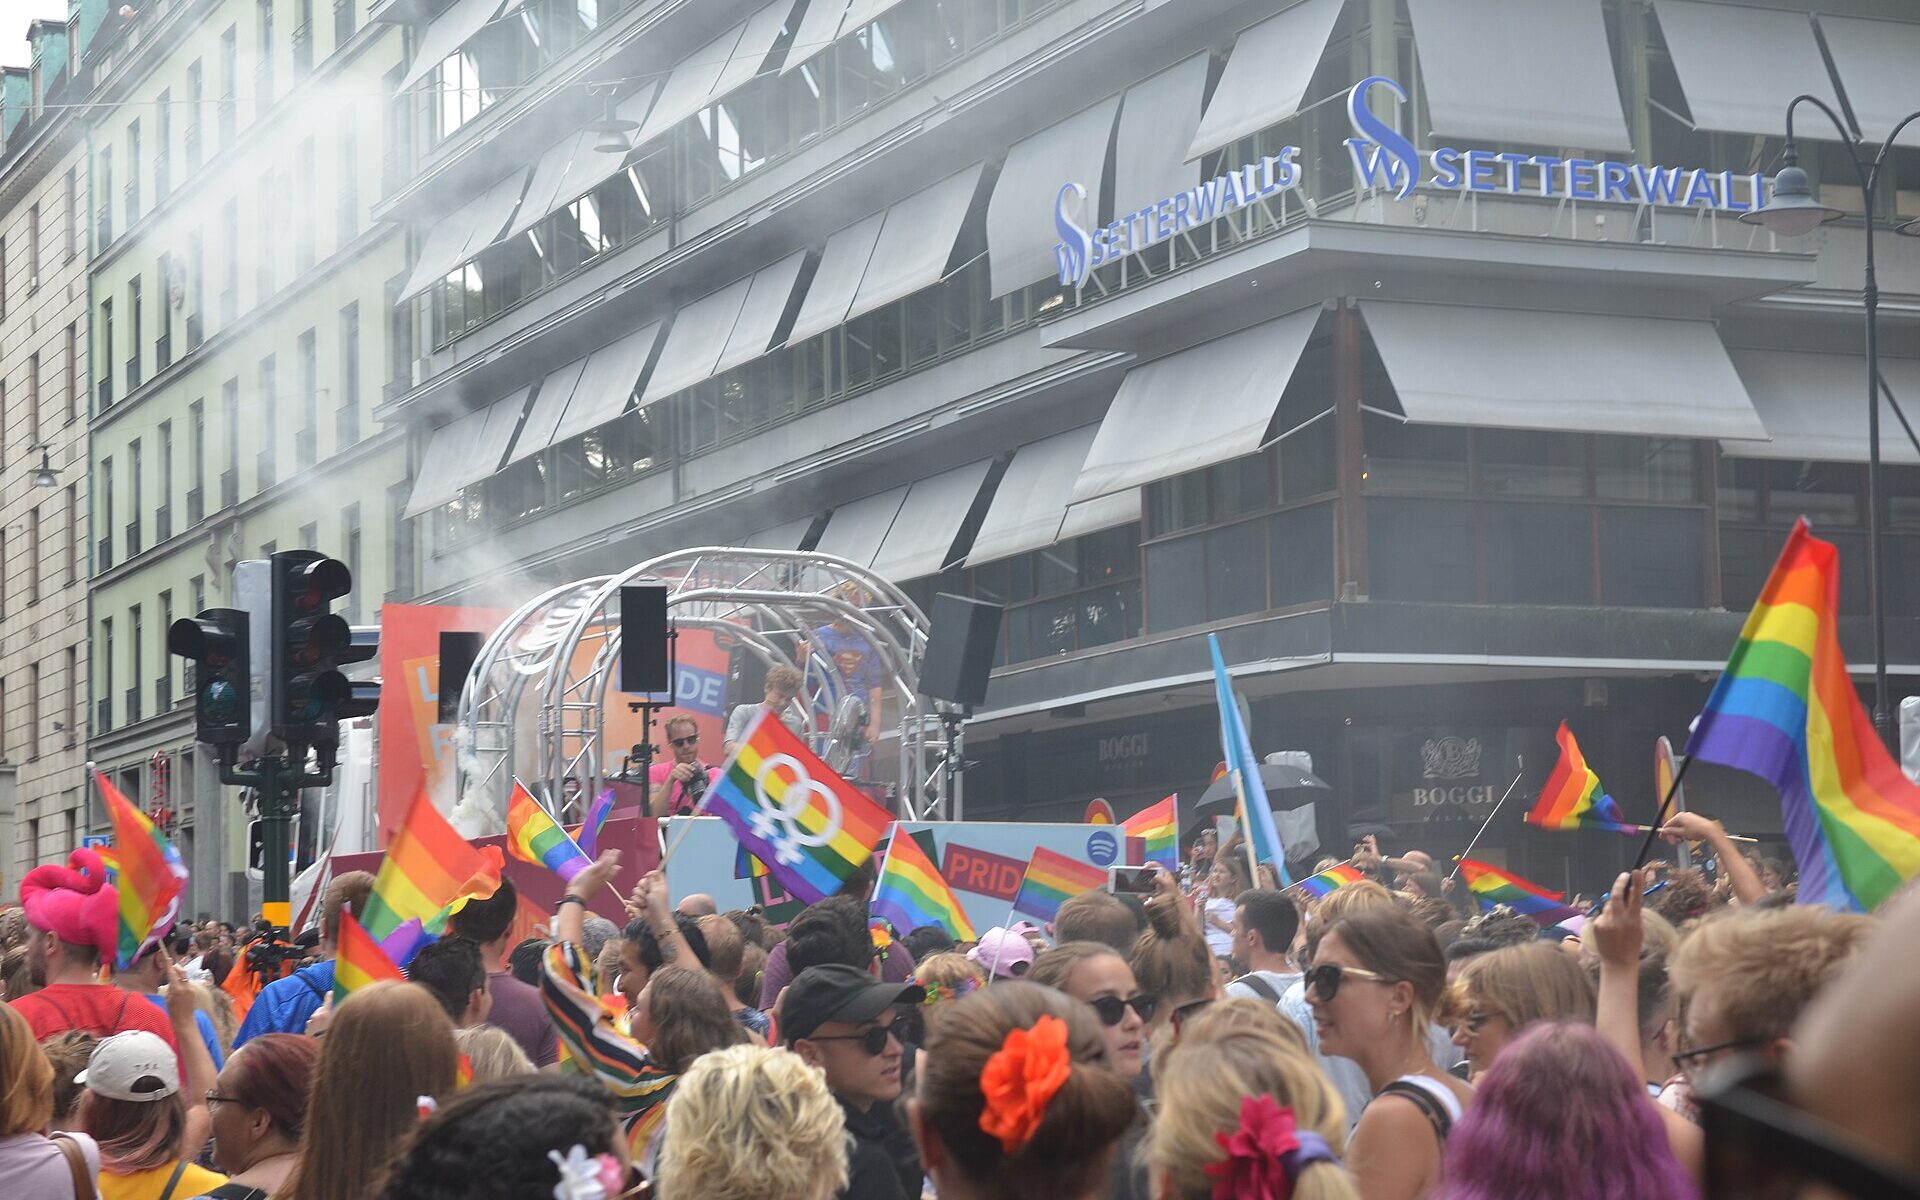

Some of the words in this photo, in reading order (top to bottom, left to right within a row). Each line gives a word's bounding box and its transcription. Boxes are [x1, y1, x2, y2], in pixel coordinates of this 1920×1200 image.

[1429, 146, 1766, 211] SETTERWALL
[1091, 145, 1302, 266] SETTERWALLS
[1098, 732, 1149, 762] BOGGI
[1413, 785, 1495, 806] BOGGI
[948, 852, 1022, 895] PRID
